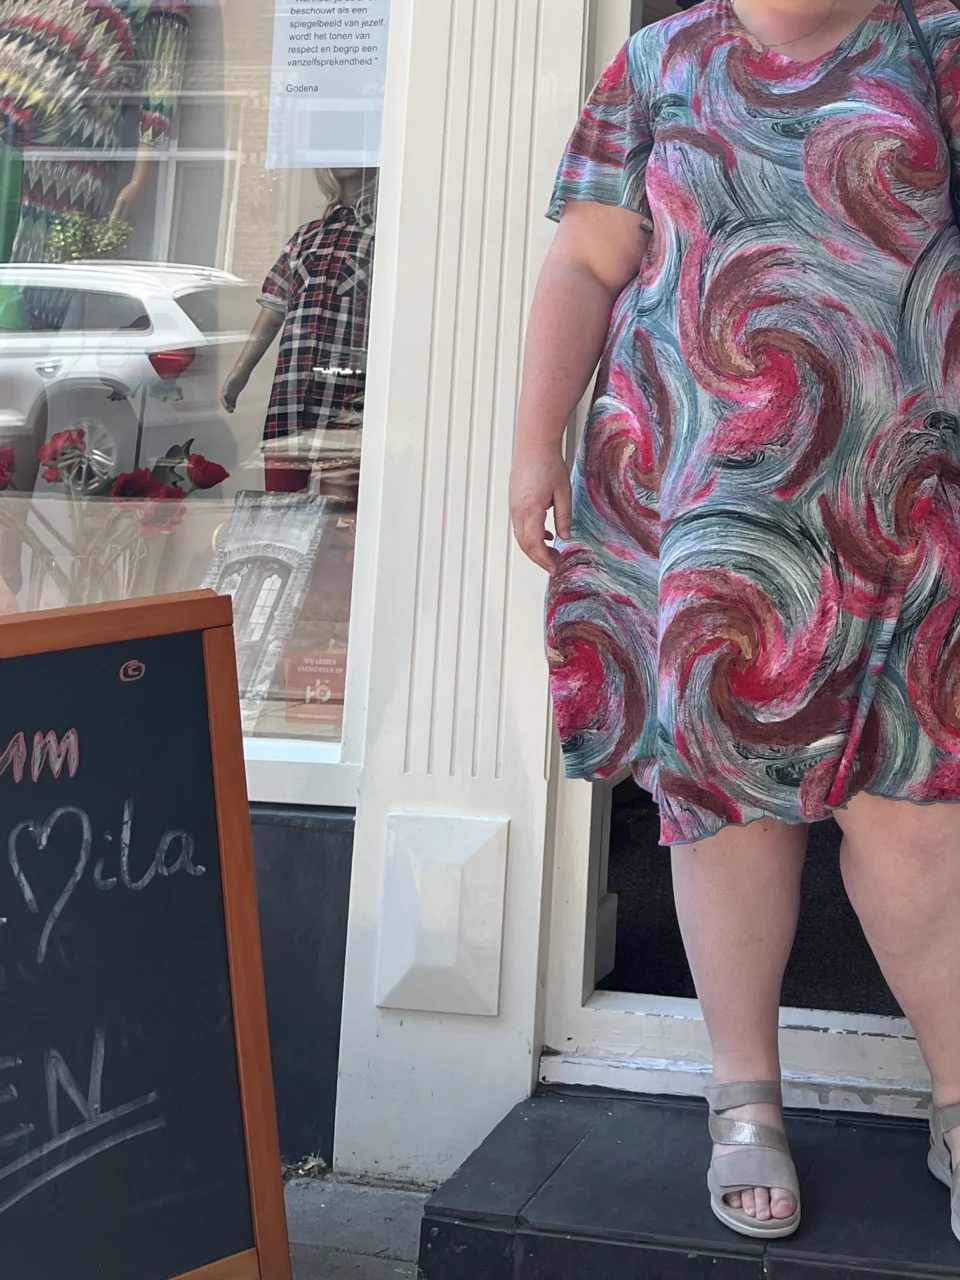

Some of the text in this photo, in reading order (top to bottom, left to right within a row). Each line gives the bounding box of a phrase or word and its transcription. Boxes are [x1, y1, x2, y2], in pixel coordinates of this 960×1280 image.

[290, 7, 368, 15] beschouwt als een
[289, 19, 342, 30] spiegelbeeld
[344, 20, 360, 28] van
[288, 32, 312, 41] wordt
[313, 32, 327, 40] het
[329, 32, 353, 41] tonen
[287, 44, 378, 55] respect en begrip een
[285, 83, 319, 93] Godena
